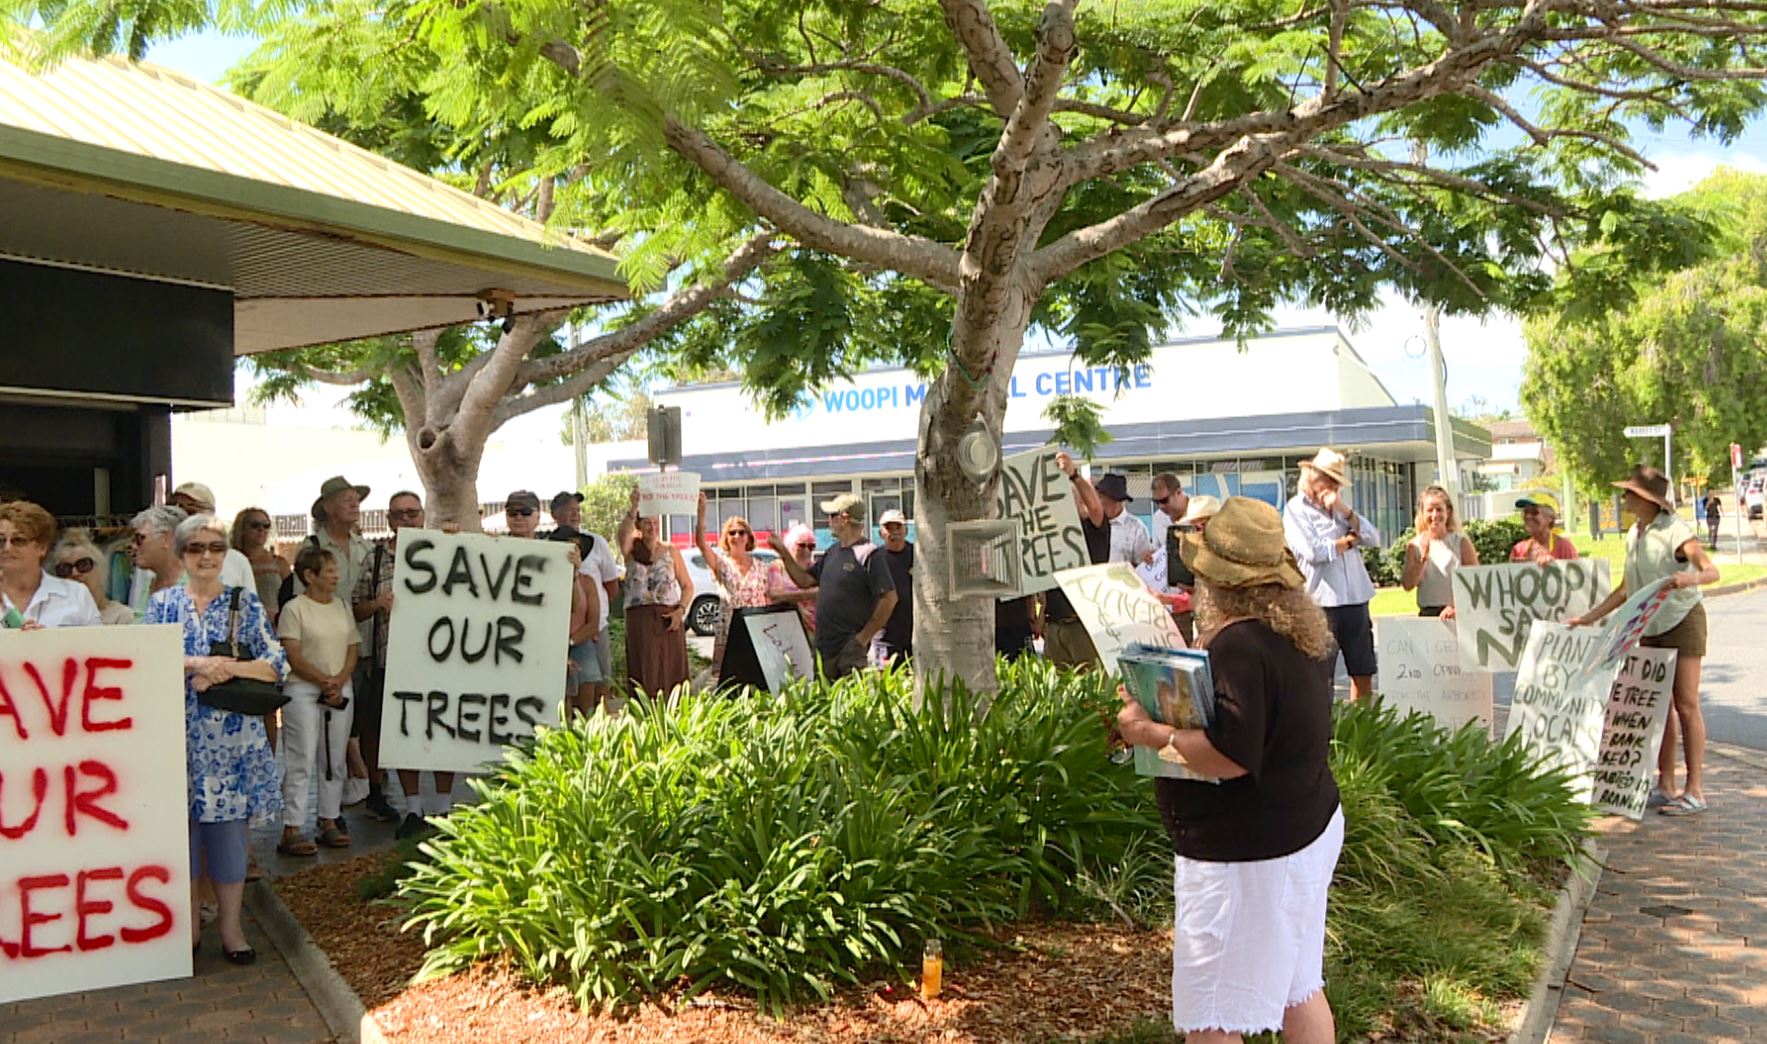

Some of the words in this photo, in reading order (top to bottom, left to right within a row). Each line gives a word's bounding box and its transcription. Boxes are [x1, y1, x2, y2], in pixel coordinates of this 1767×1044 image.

[823, 387, 898, 413] WOOPI
[1036, 363, 1152, 396] CENTRE
[997, 452, 1066, 519] AVE
[1011, 504, 1057, 536] HE
[404, 539, 548, 606] SAVE
[1456, 560, 1598, 609] WHOOPI
[428, 615, 526, 667] OUR
[1514, 683, 1609, 715] COMMUNITY
[1542, 663, 1578, 691] BY
[1623, 687, 1661, 708] TREE
[392, 690, 545, 744] TREES
[1609, 733, 1645, 749] BANK
[1612, 712, 1652, 731] WHEN
[0, 759, 129, 839] UR
